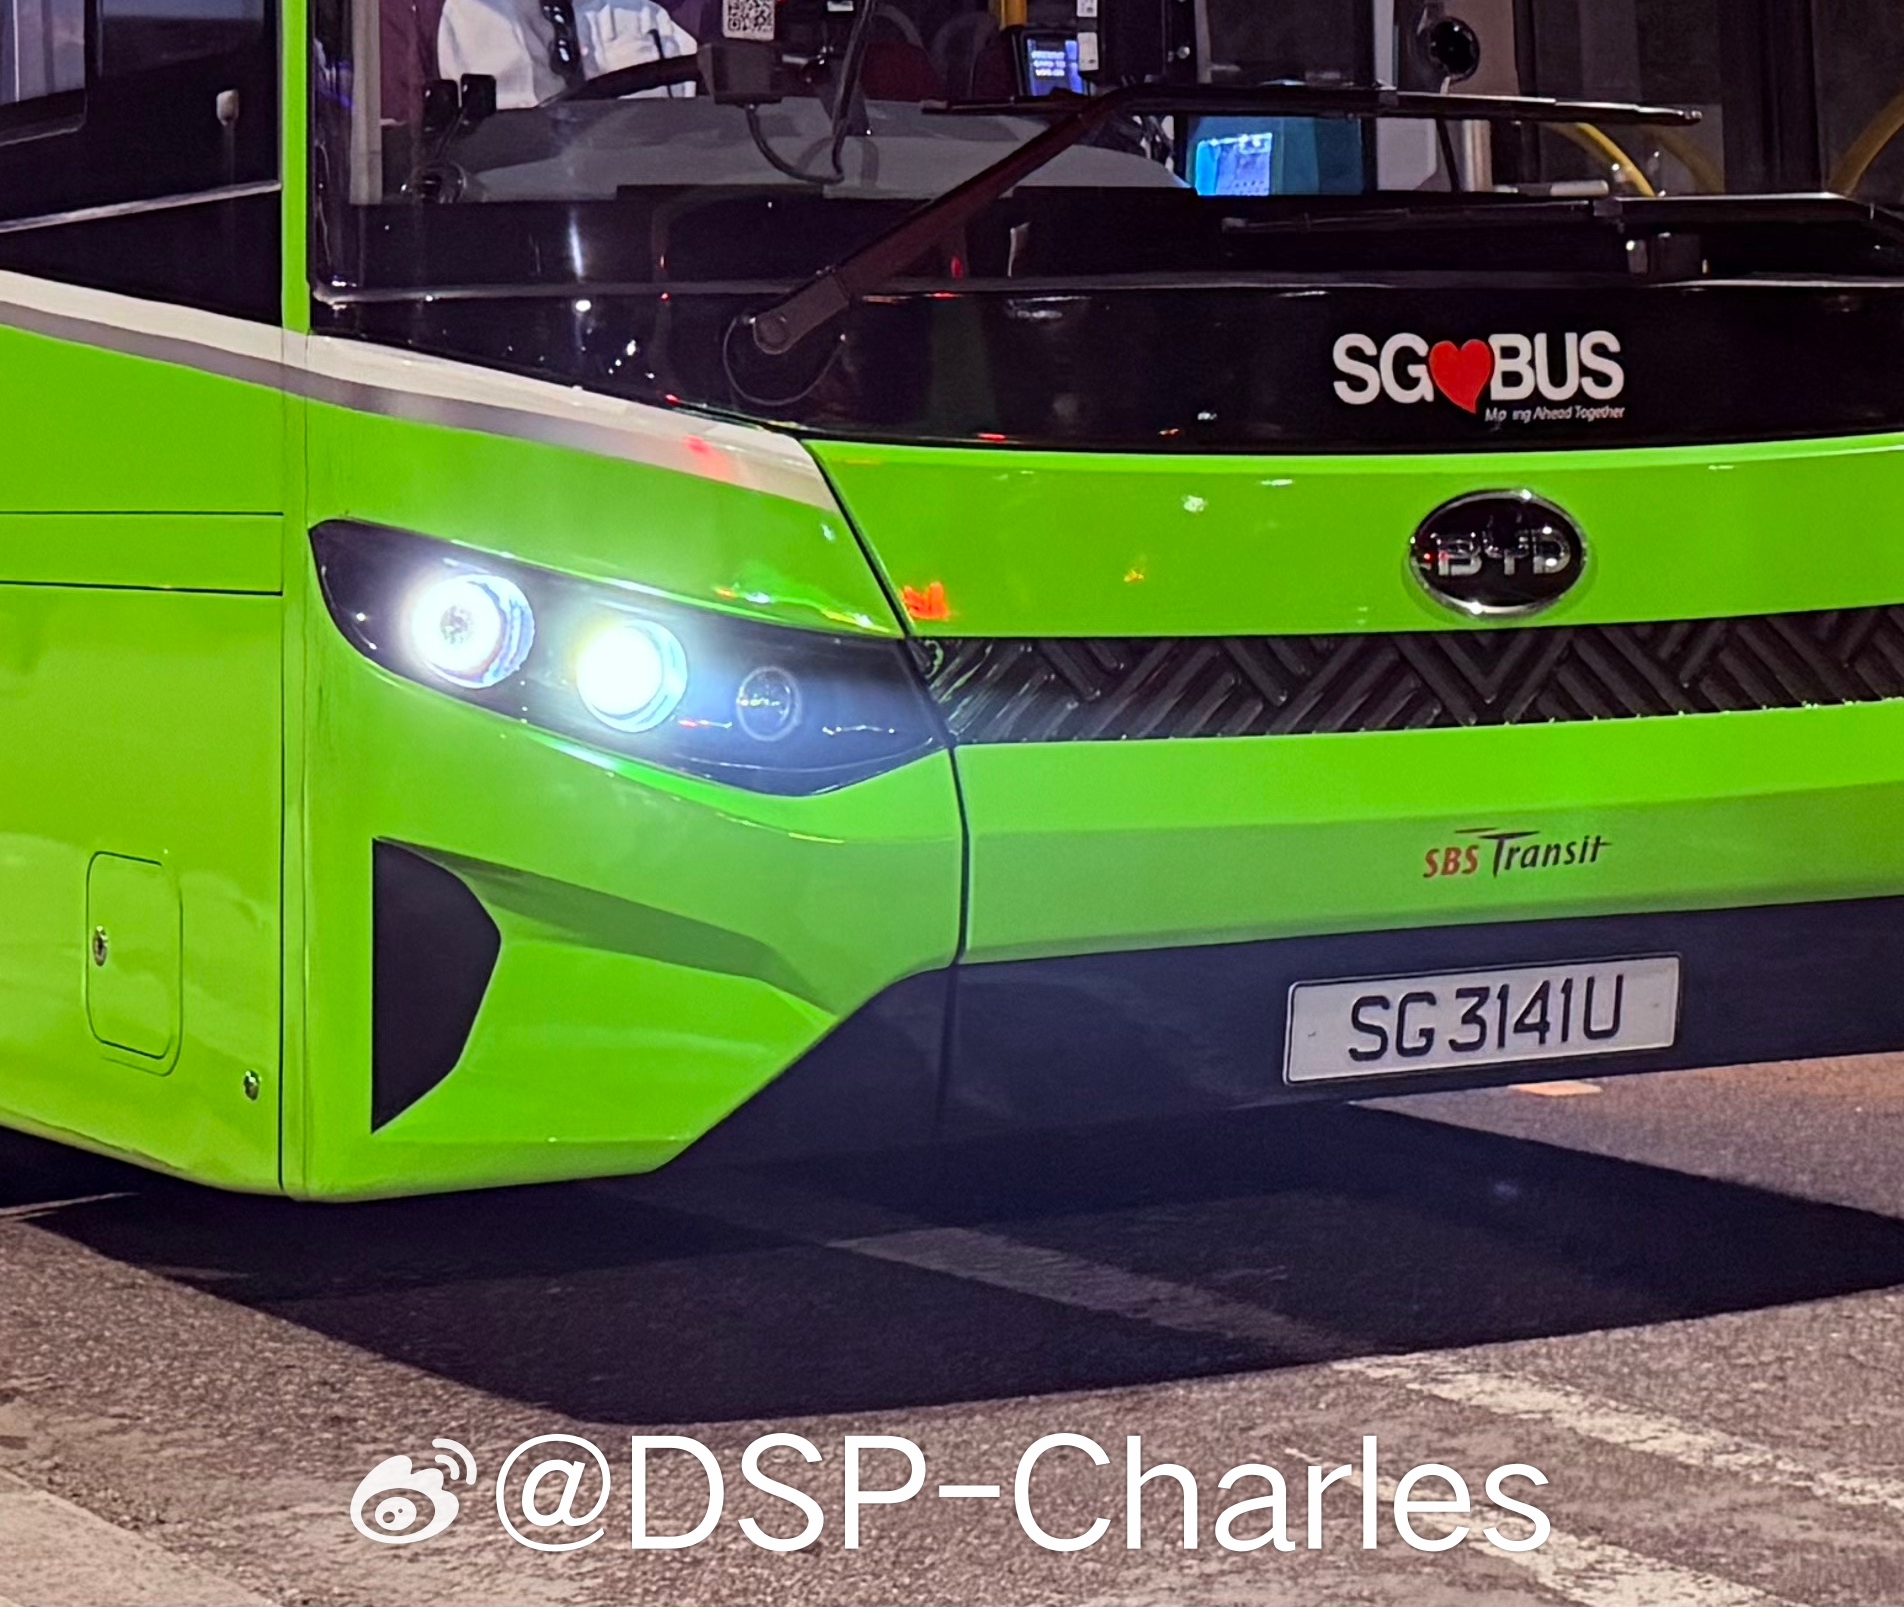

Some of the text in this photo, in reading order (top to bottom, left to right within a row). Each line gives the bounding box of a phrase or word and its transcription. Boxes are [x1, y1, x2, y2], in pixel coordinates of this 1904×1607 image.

[1484, 404, 1626, 425] Moing Ahead Together
[1434, 515, 1573, 578] BYD
[1422, 830, 1613, 879] SBS Transit
